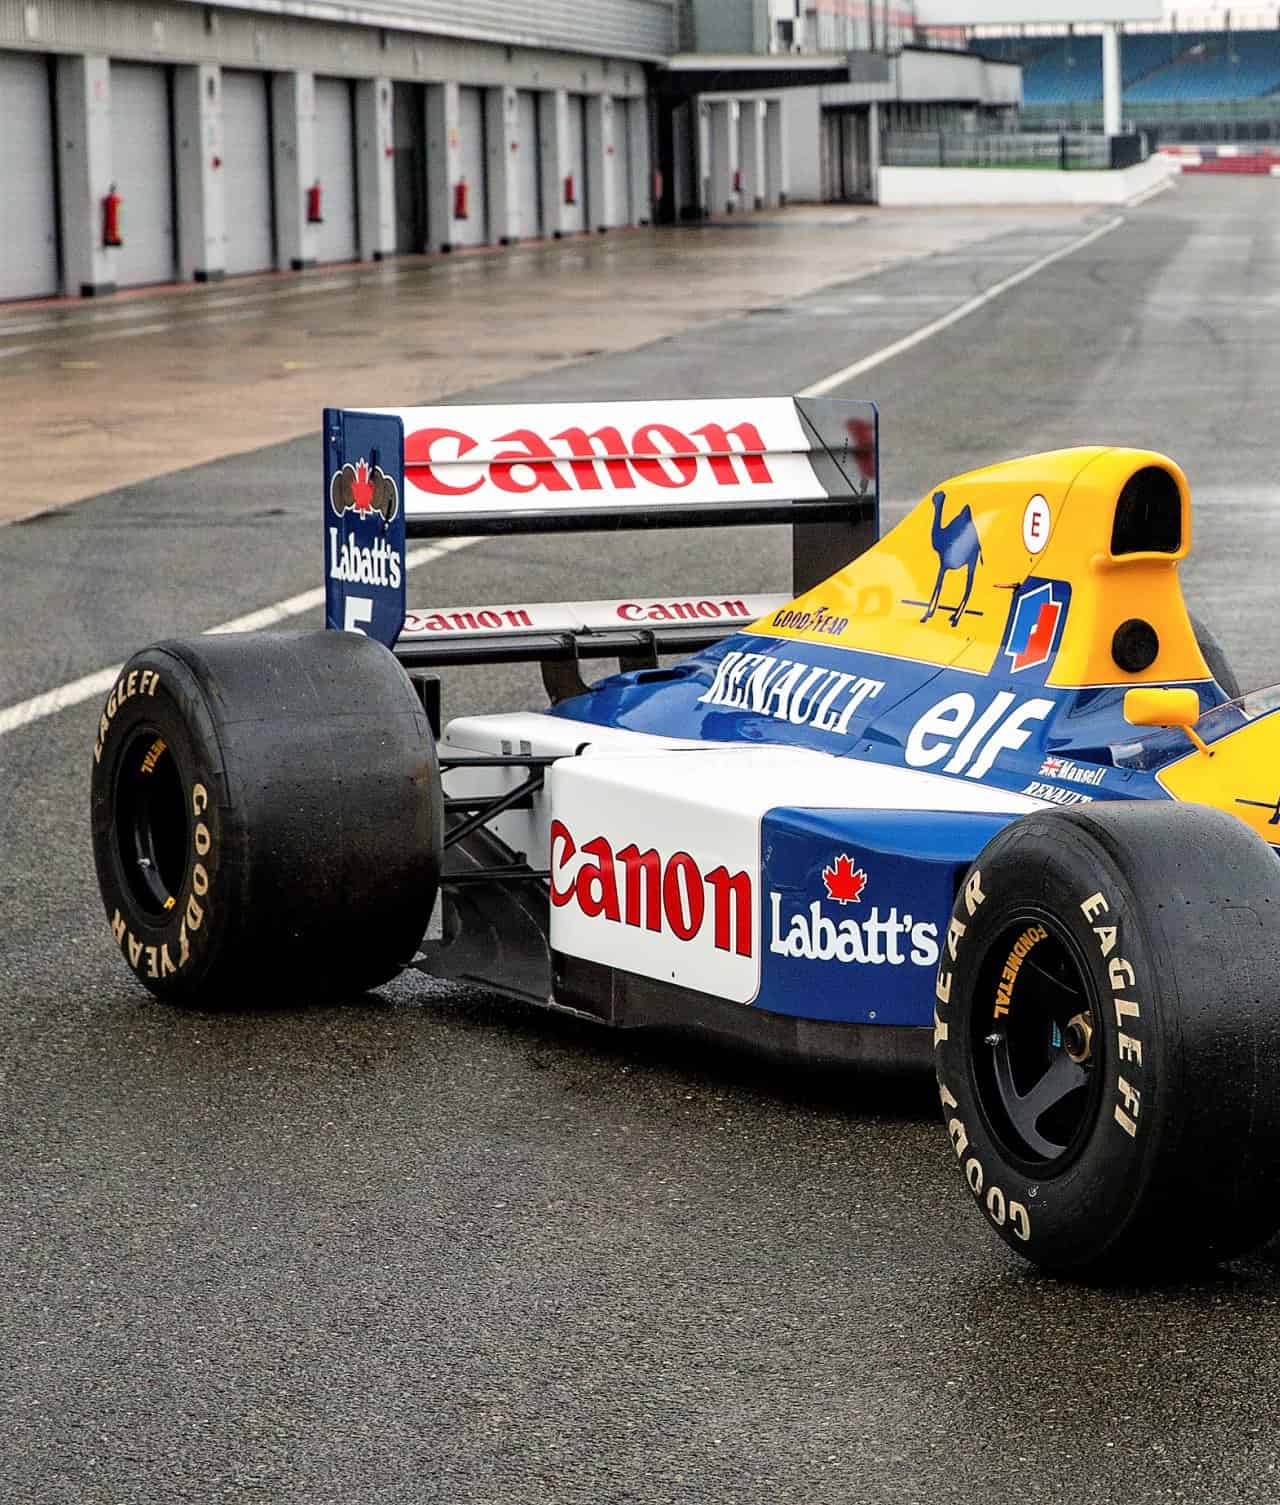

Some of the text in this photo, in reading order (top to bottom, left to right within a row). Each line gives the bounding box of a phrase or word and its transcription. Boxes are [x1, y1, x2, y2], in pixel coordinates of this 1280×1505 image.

[403, 421, 774, 496] Canon
[329, 527, 401, 589] Labatt's
[1031, 512, 1041, 538] E
[616, 598, 751, 622] Canon
[698, 650, 885, 735] RENAULT
[904, 690, 1055, 779] elf
[1056, 759, 1107, 786] Mansell
[550, 818, 753, 959] Canon
[769, 890, 940, 966] Labatt's
[993, 923, 1048, 1019] FONDMETAL
[1079, 891, 1143, 1067] EAGLE
